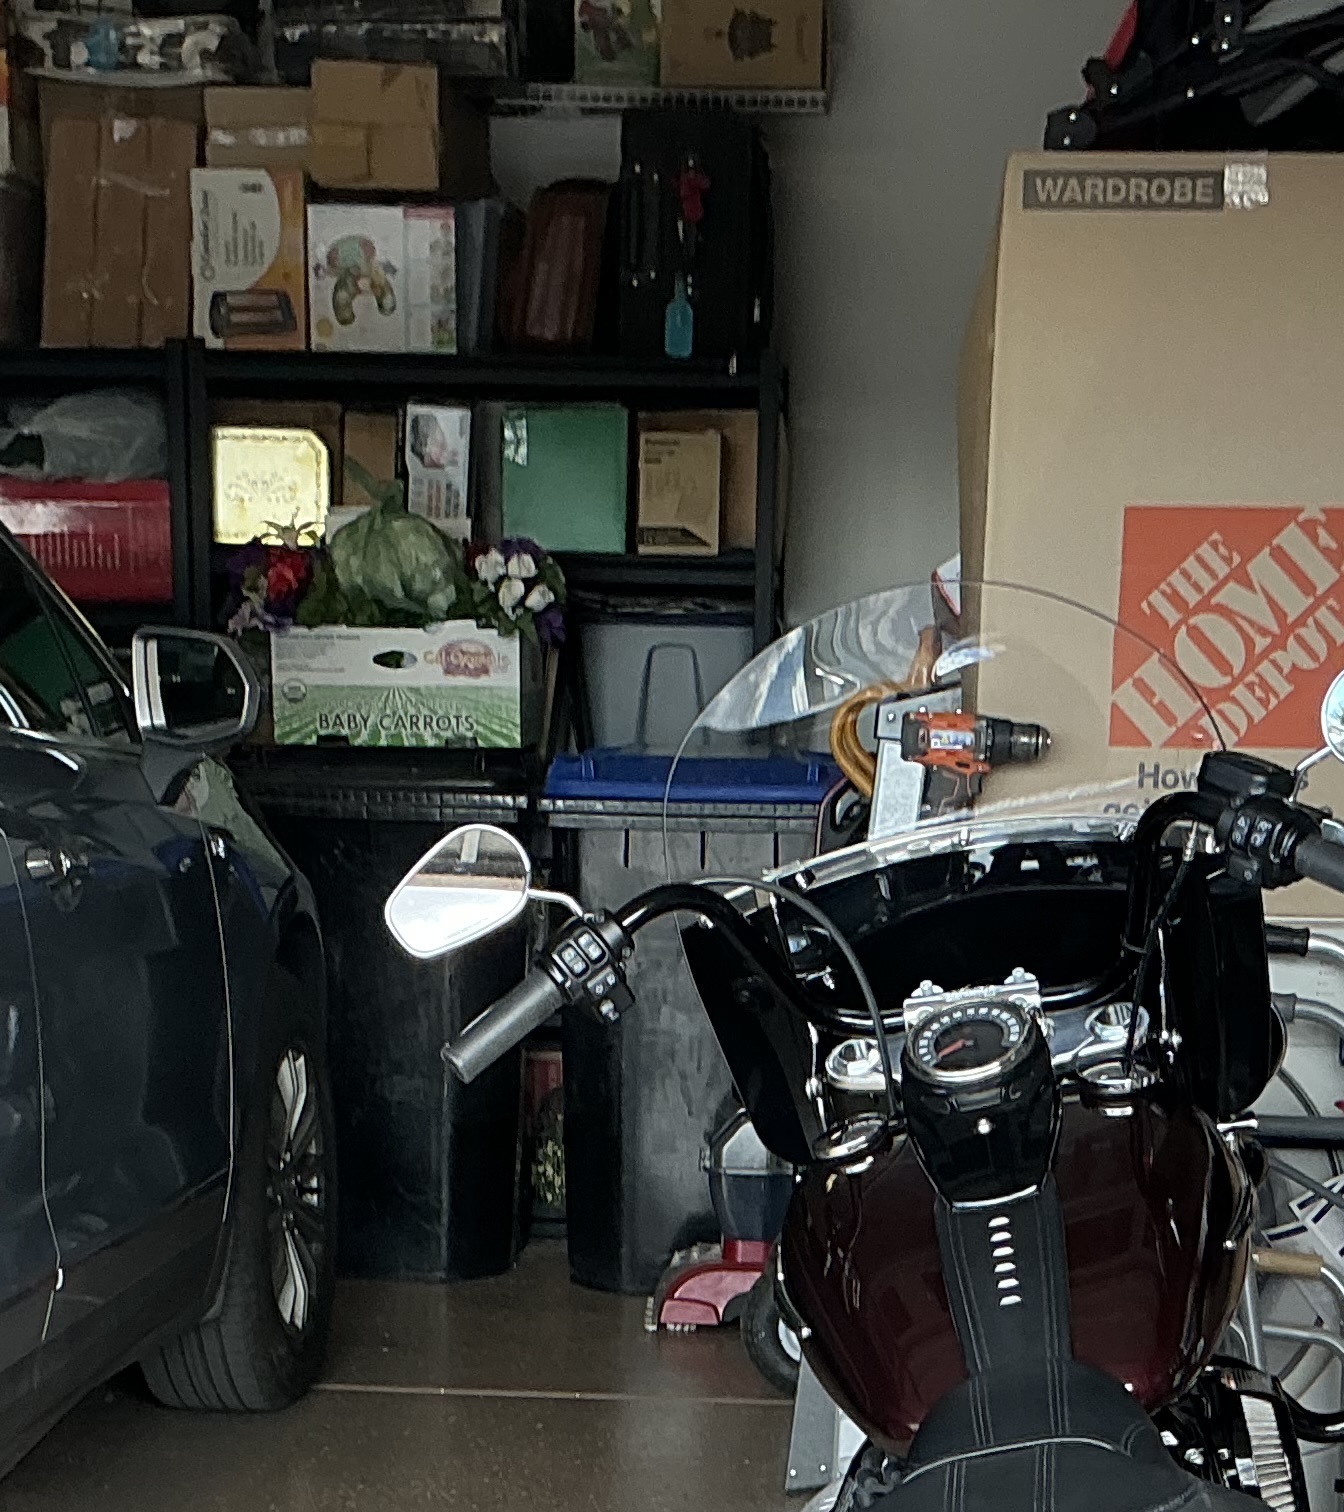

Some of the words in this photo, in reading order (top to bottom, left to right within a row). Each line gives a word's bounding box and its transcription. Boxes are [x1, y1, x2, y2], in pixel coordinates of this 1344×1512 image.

[1034, 176, 1215, 205] WARDROBE
[1141, 531, 1243, 632] THE
[317, 713, 371, 731] BABY
[378, 713, 476, 733] CARROTS
